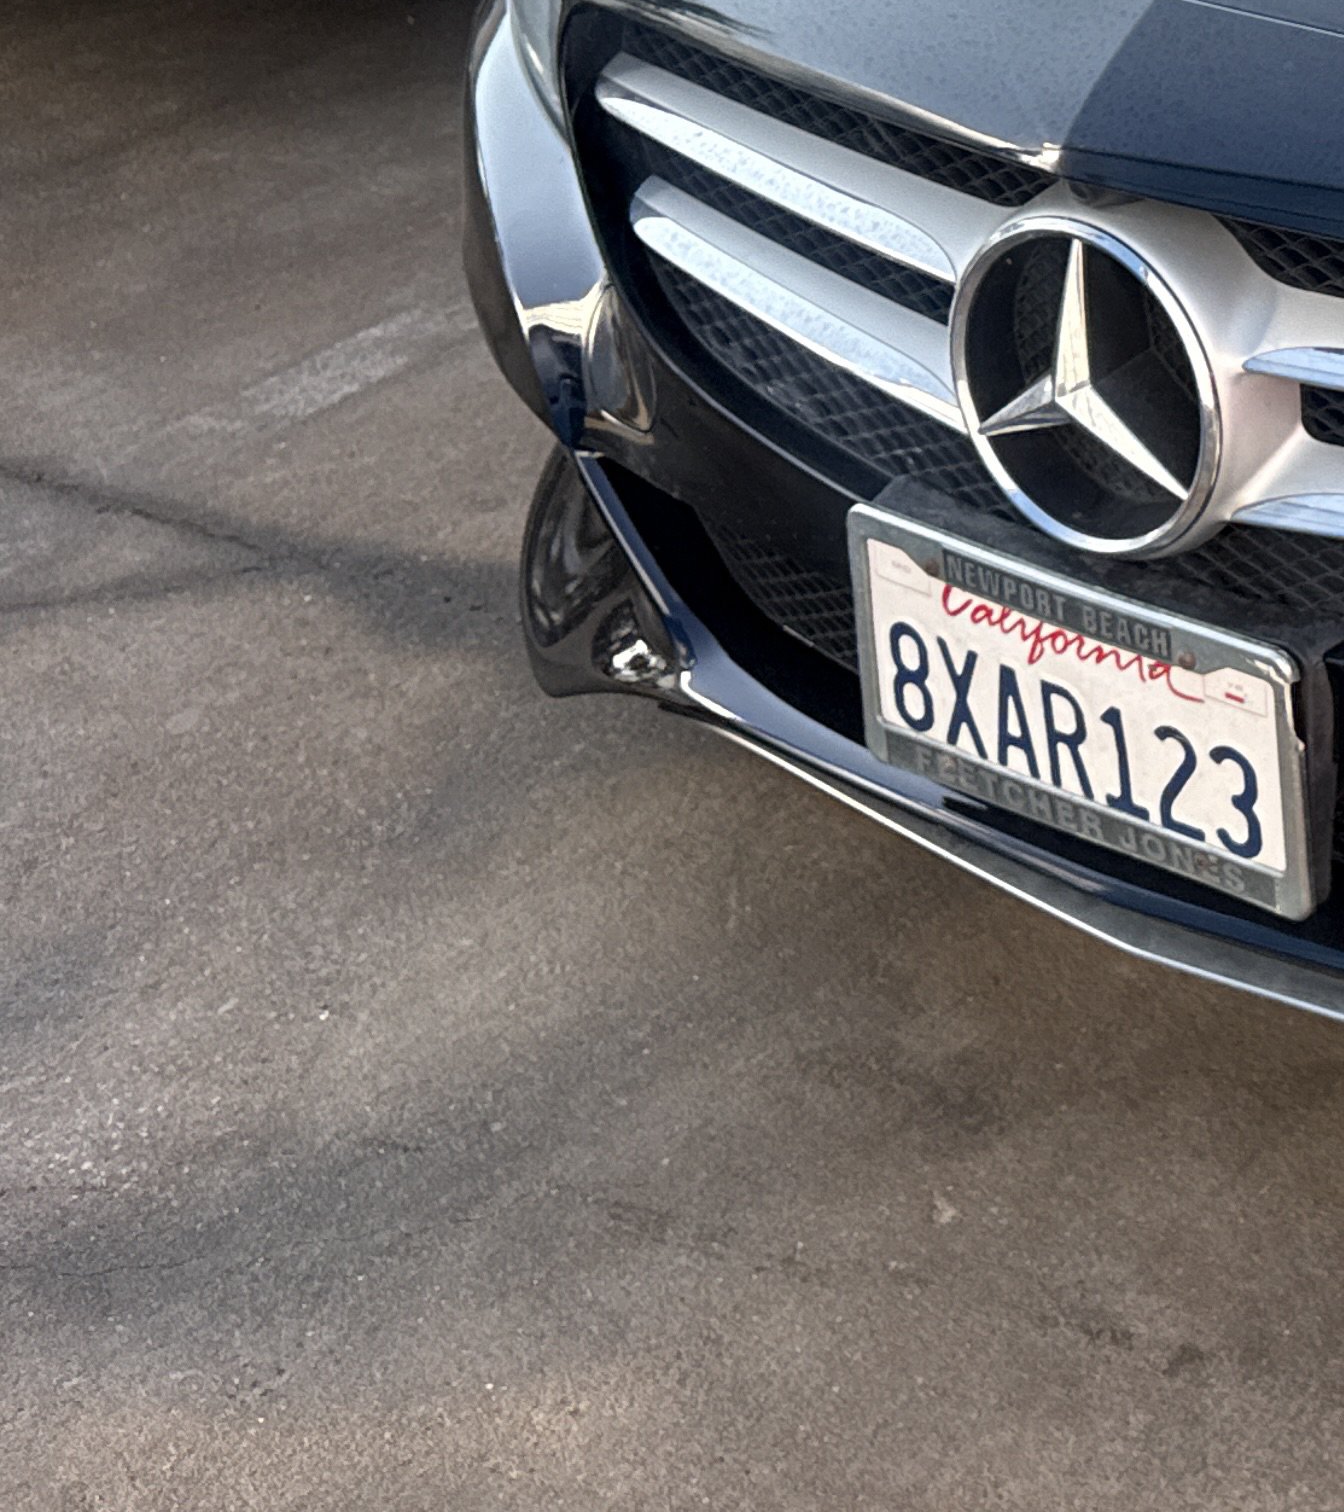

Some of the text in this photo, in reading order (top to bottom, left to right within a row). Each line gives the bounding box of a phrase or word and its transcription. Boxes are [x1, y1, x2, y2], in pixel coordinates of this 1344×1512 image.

[944, 553, 1170, 658] NEWPORT BEACH
[889, 620, 1264, 859] 8XAR123
